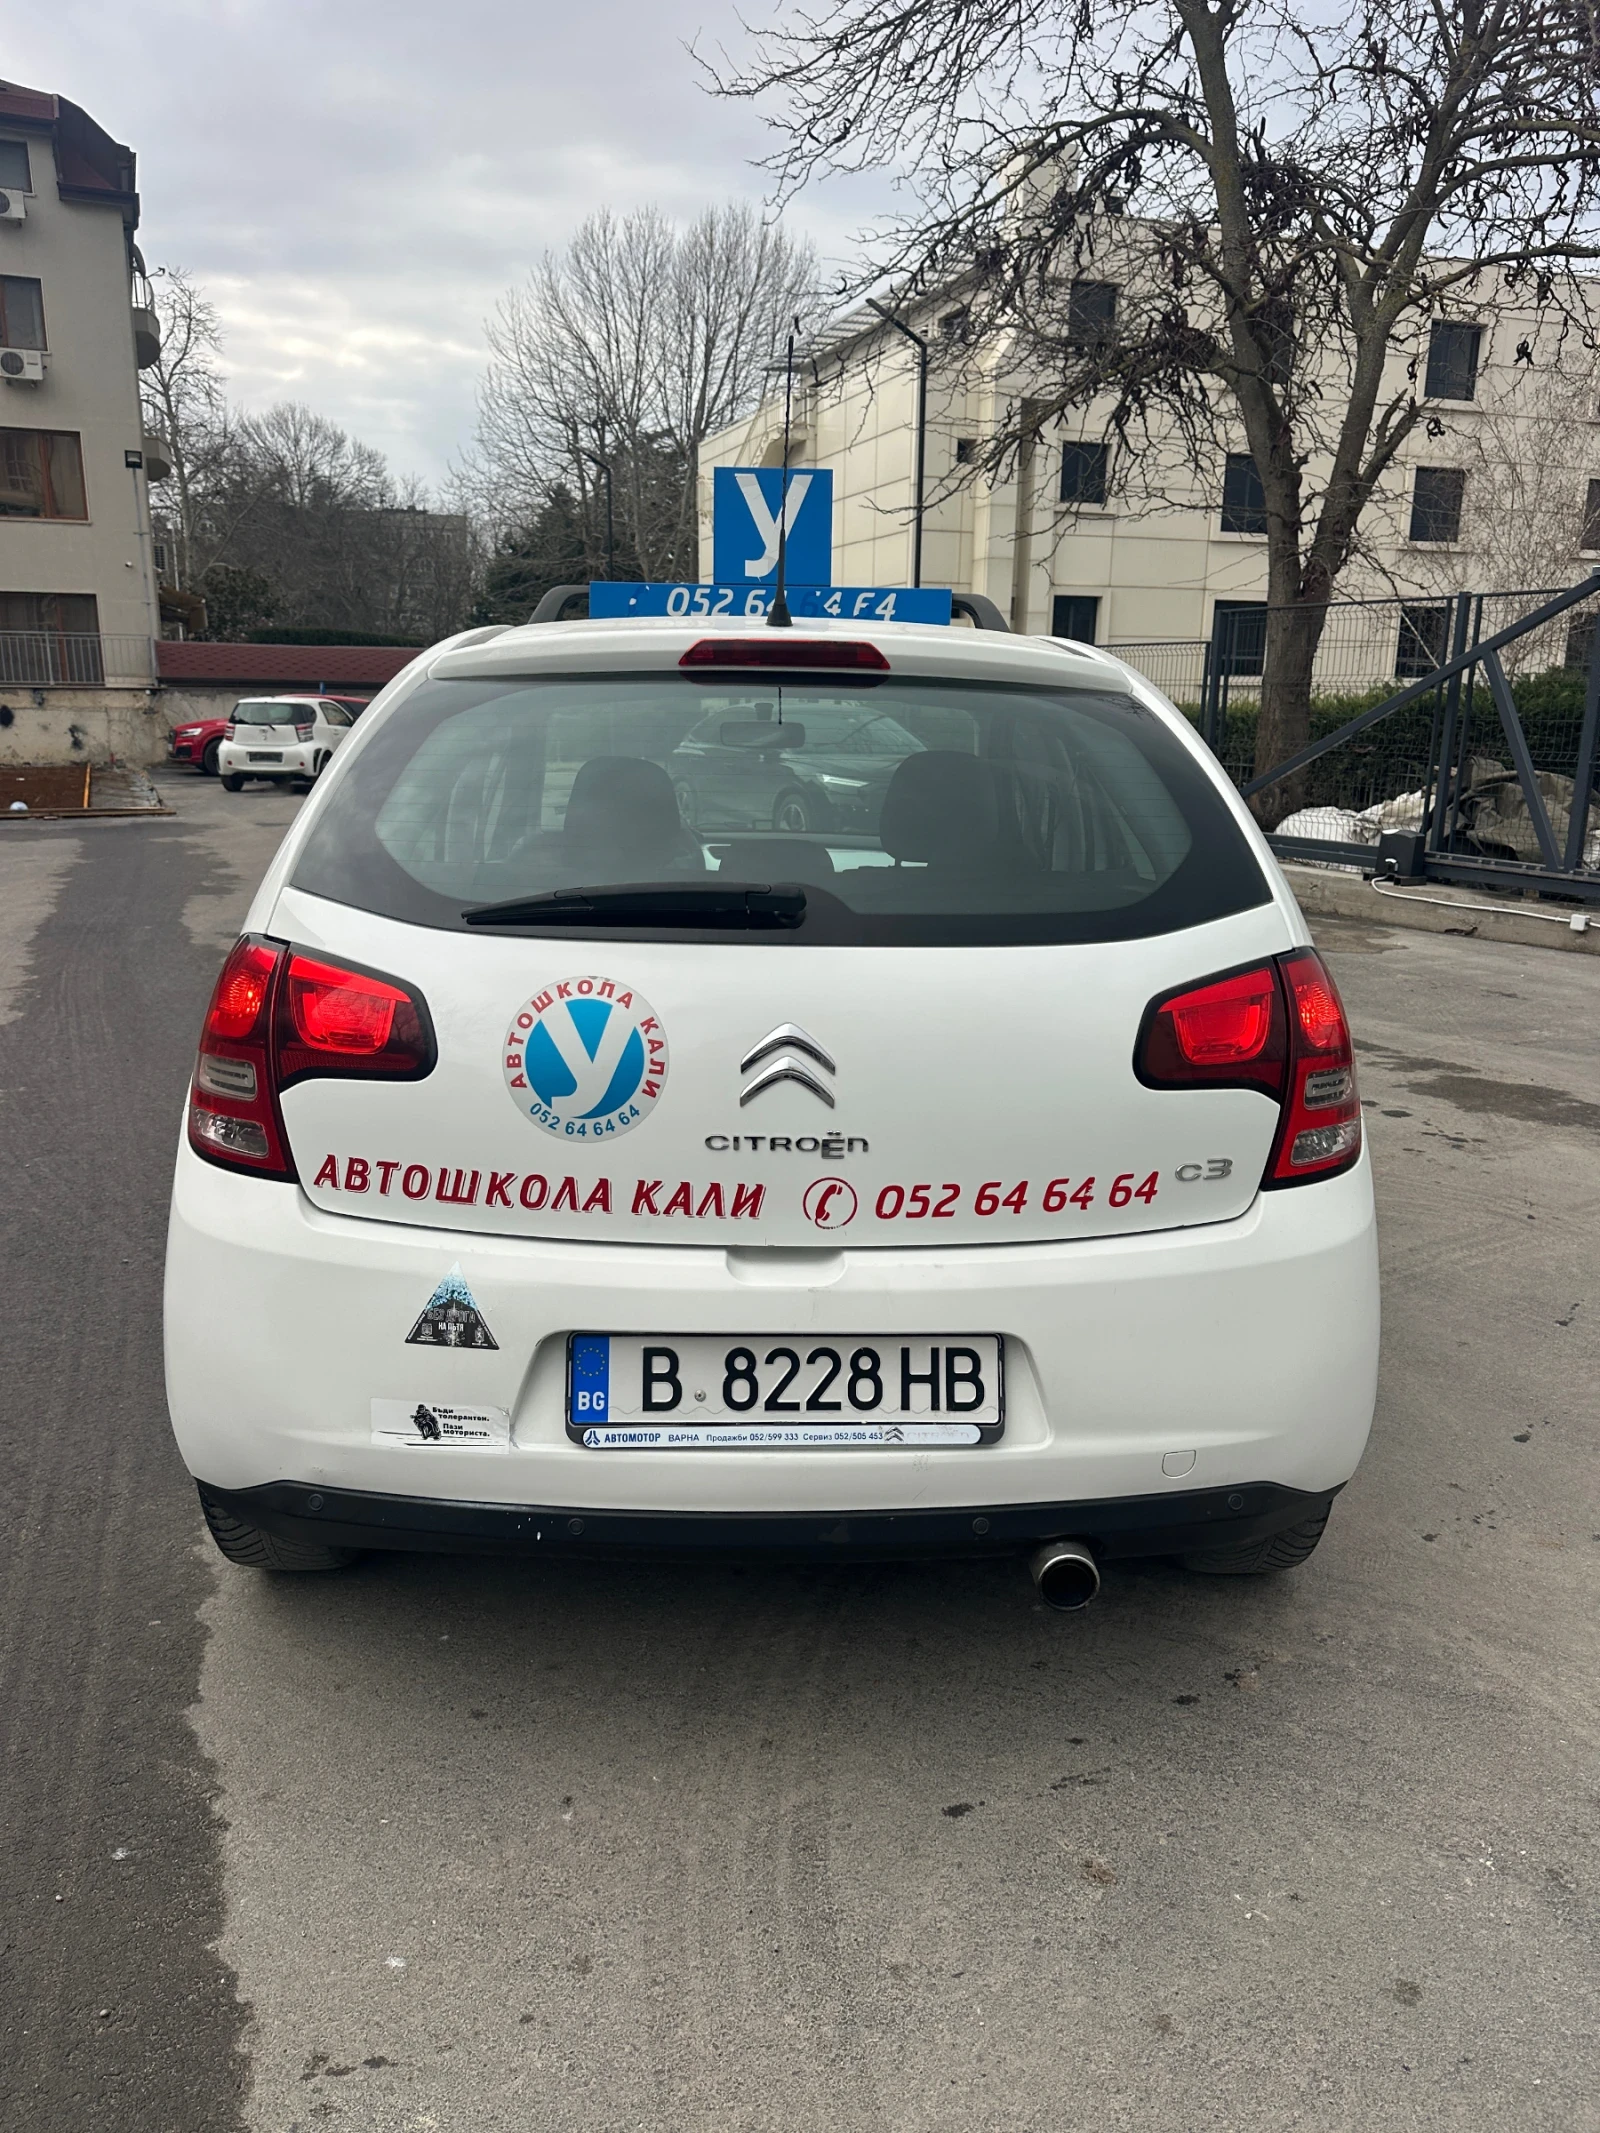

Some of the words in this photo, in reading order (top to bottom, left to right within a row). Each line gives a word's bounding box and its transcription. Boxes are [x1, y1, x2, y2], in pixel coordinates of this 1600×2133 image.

[734, 473, 813, 577] У
[666, 587, 734, 616] 052
[506, 979, 633, 1089] АВТОШКОЛА
[640, 1016, 665, 1098] КАЛИ
[530, 1102, 561, 1130] 052
[565, 1122, 587, 1136] 64
[593, 1118, 615, 1136] 64
[618, 1104, 640, 1125] 64
[314, 1154, 614, 1214] АВТОШКОЛА
[631, 1179, 767, 1219] КАЛИ
[1174, 1158, 1234, 1182] C3
[874, 1183, 961, 1219] 052
[973, 1181, 1028, 1214] 64
[1041, 1177, 1094, 1213] 64
[1108, 1171, 1158, 1208] 64
[722, 1347, 884, 1412] 8228
[577, 1391, 605, 1411] BG
[604, 1433, 661, 1443] АВТОМОТОР
[668, 1434, 700, 1442] ВАРНА
[706, 1434, 748, 1443] Продажби
[749, 1433, 782, 1442] 052/599
[784, 1433, 799, 1442] 333
[803, 1434, 832, 1442] Сервиз
[834, 1433, 866, 1441] 052/505
[868, 1433, 883, 1441] 453
